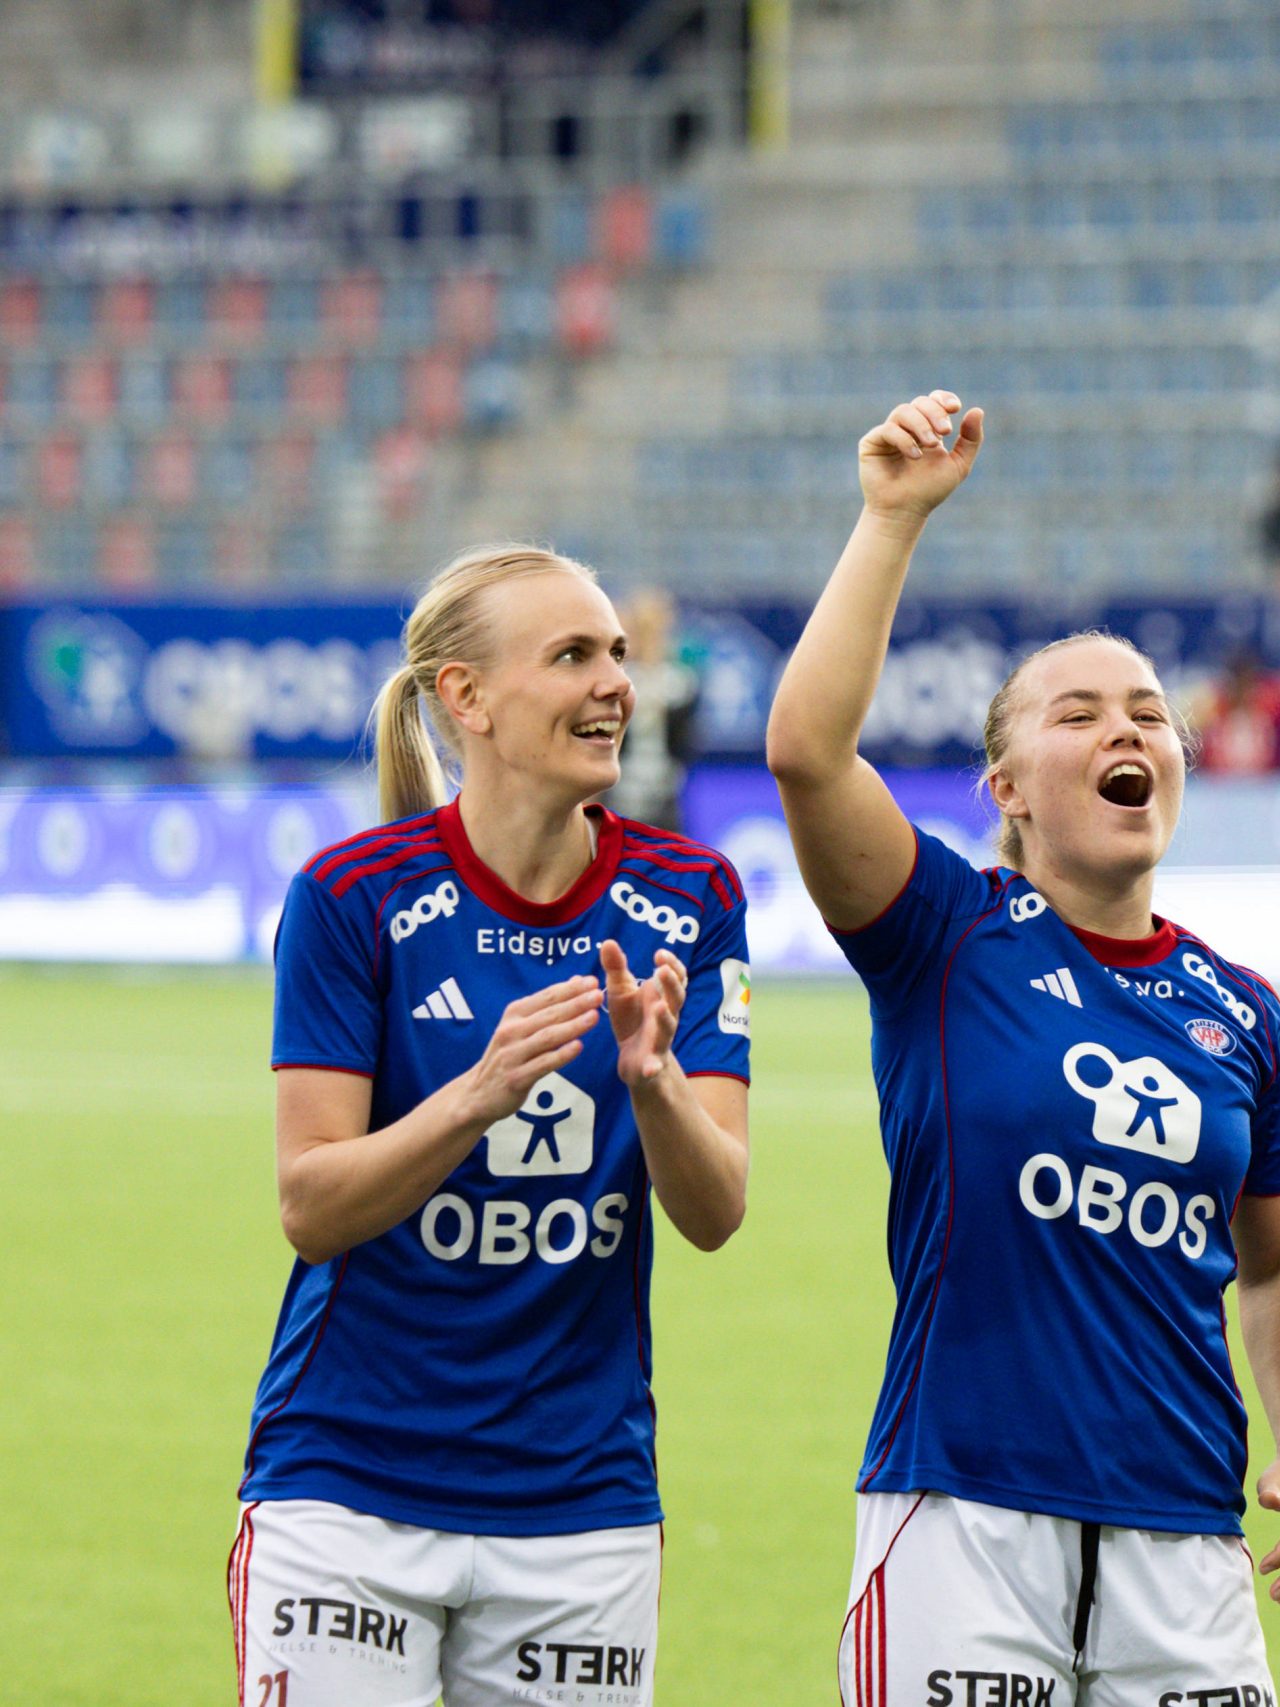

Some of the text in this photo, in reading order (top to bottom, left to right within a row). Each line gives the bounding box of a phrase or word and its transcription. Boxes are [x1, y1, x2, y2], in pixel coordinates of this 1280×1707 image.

[610, 881, 700, 945] coop
[420, 1193, 629, 1265] OBOS
[1019, 1153, 1216, 1260] OBOS
[272, 1598, 408, 1656] STERK
[258, 1669, 289, 1707] 21
[516, 1641, 646, 1687] STERK
